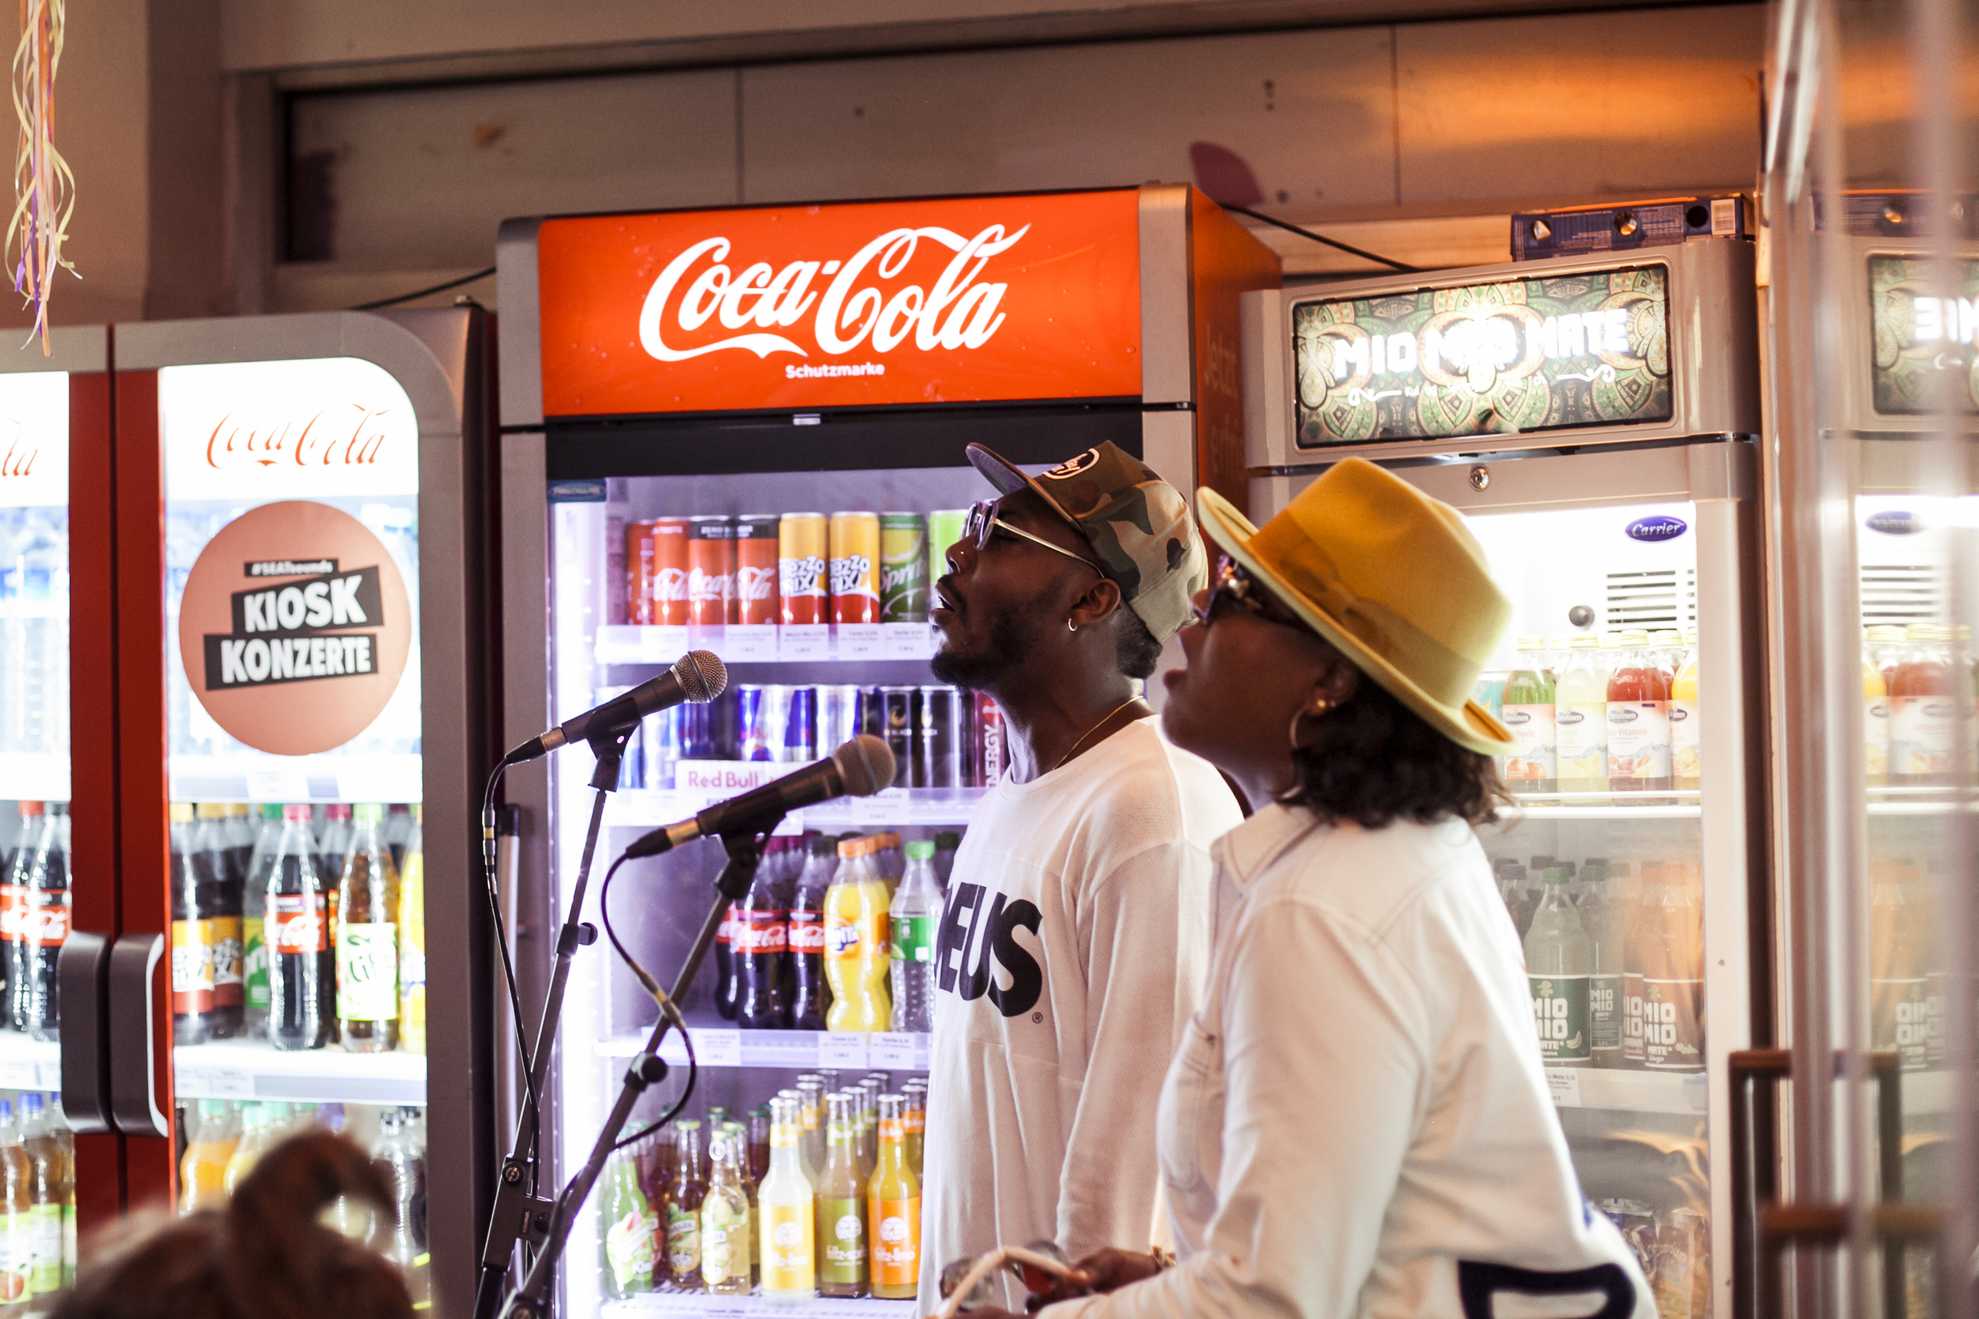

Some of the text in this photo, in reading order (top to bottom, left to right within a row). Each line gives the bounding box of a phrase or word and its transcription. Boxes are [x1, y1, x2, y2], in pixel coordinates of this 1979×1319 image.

[639, 224, 1030, 361] Coca-Cola
[785, 363, 885, 379] Schutzmarke
[1333, 332, 1417, 380] MIO
[1525, 309, 1629, 359] MATE
[207, 404, 390, 469] CocaCola
[1632, 522, 1681, 537] Carrier
[243, 575, 368, 633] KIOSK
[220, 636, 372, 684] KONZERTE
[688, 770, 759, 788] Red Bull
[984, 724, 1000, 788] NERGY
